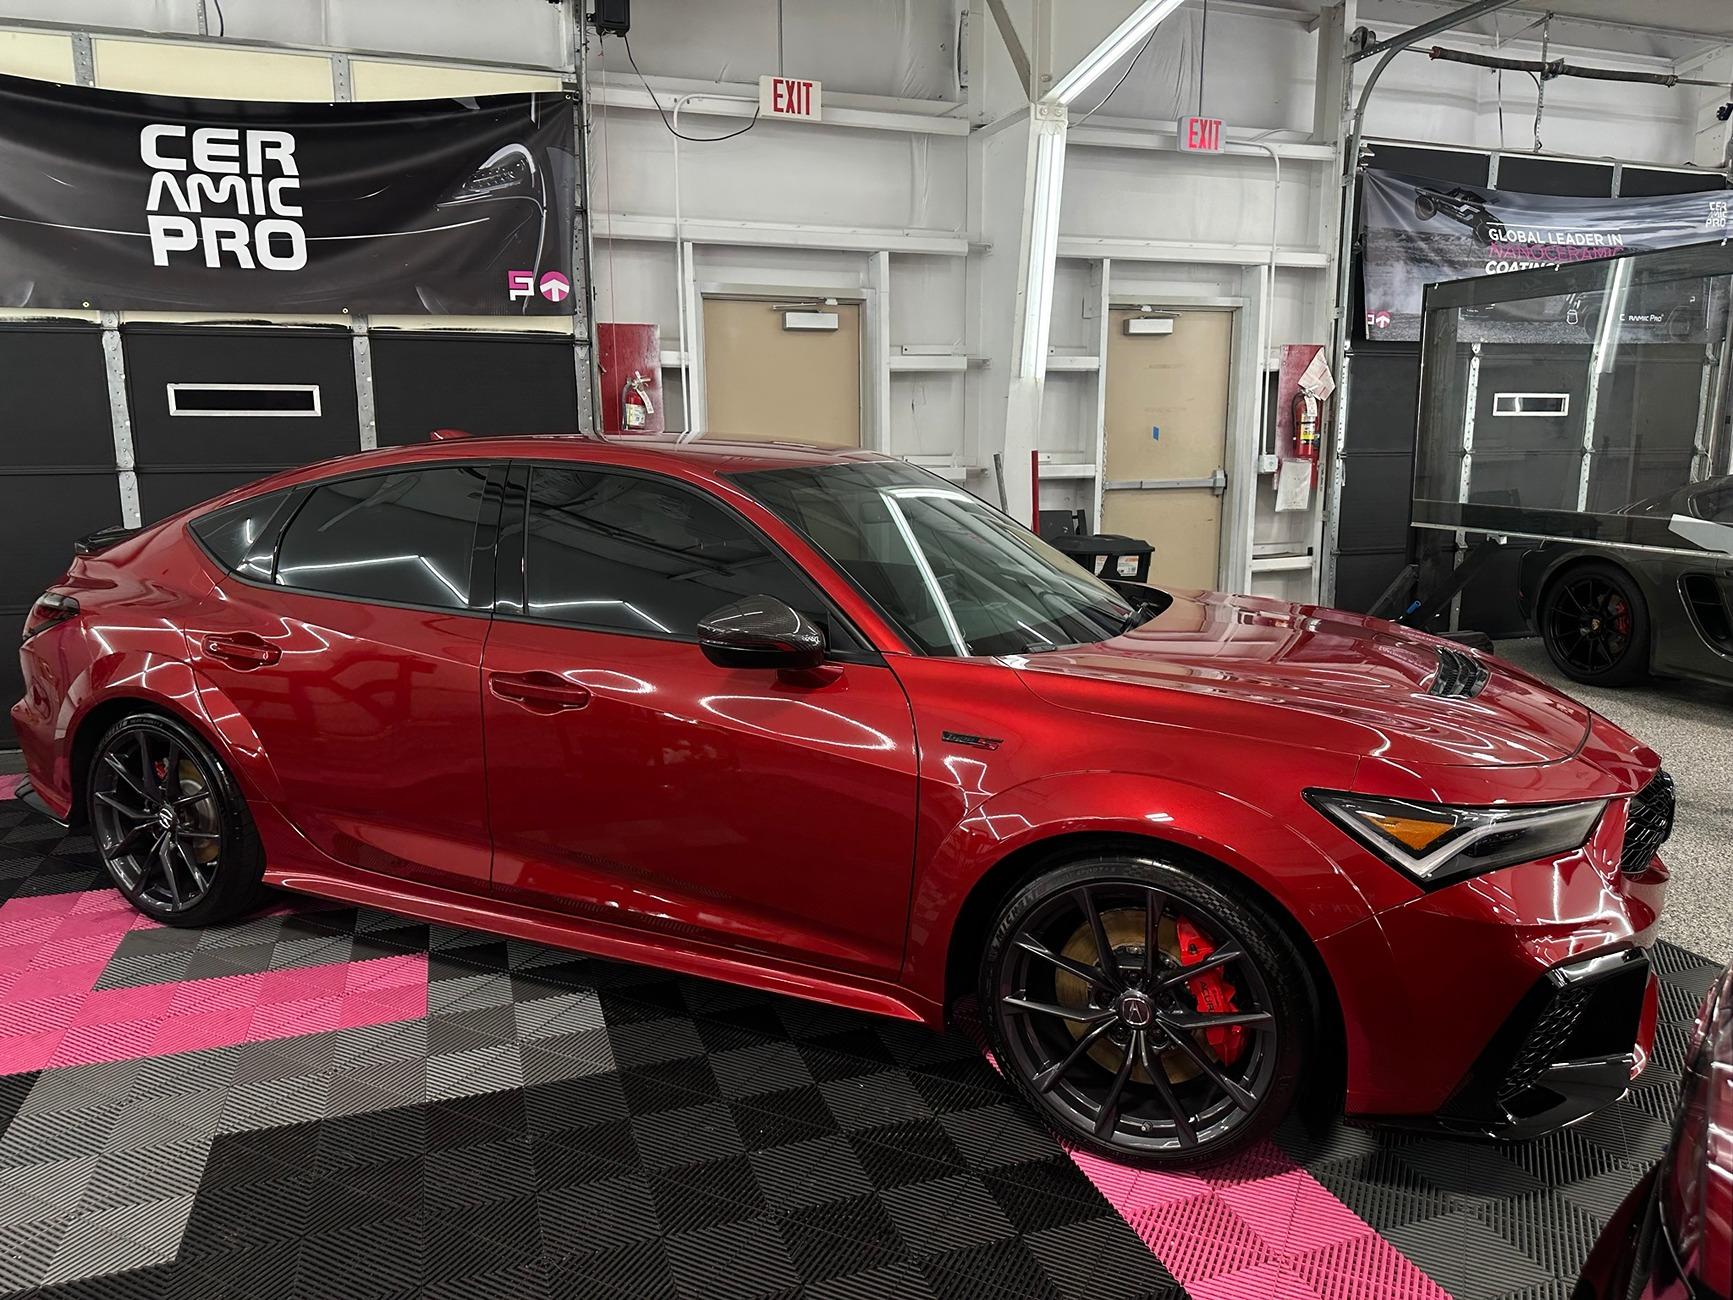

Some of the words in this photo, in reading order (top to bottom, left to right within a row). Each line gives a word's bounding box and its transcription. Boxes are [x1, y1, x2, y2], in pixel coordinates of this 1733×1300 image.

[773, 79, 812, 115] EXIT
[140, 124, 299, 176] CER
[1189, 119, 1221, 150] EXIT
[146, 171, 303, 217] AMIC
[1709, 201, 1728, 211] CER
[1488, 228, 1546, 244] GLOBAL
[1548, 232, 1603, 246] LEADER
[1608, 234, 1624, 246] IN
[1706, 218, 1727, 228] PRO
[147, 215, 308, 271] PRO
[1200, 981, 1215, 1013] ACUR
